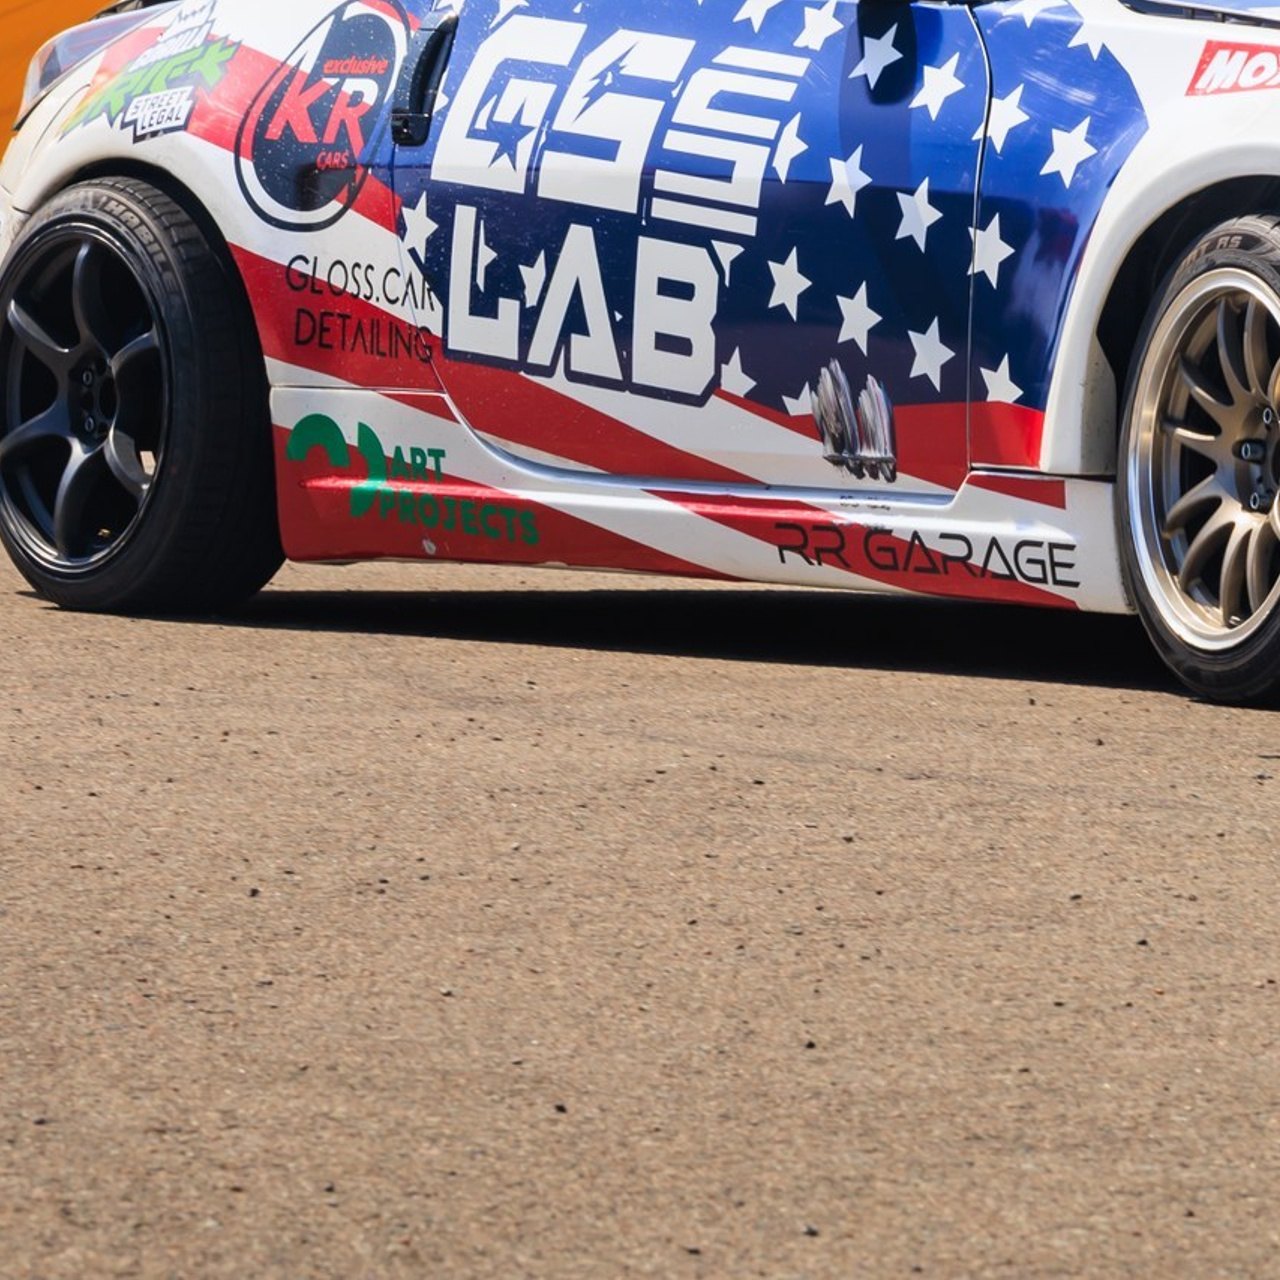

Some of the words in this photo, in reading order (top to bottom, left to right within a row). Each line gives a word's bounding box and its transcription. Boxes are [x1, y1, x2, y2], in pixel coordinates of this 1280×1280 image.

[323, 58, 389, 76] exclusive
[131, 90, 187, 116] STREET
[140, 103, 184, 131] LEGAL
[265, 77, 380, 144] KR
[316, 151, 350, 170] CARS
[447, 204, 719, 397] LAB
[294, 308, 434, 363] DETAILING
[390, 446, 446, 481] ART
[379, 490, 540, 545] PROJECTS
[774, 522, 852, 569] RR
[863, 528, 1081, 588] GARAGE
